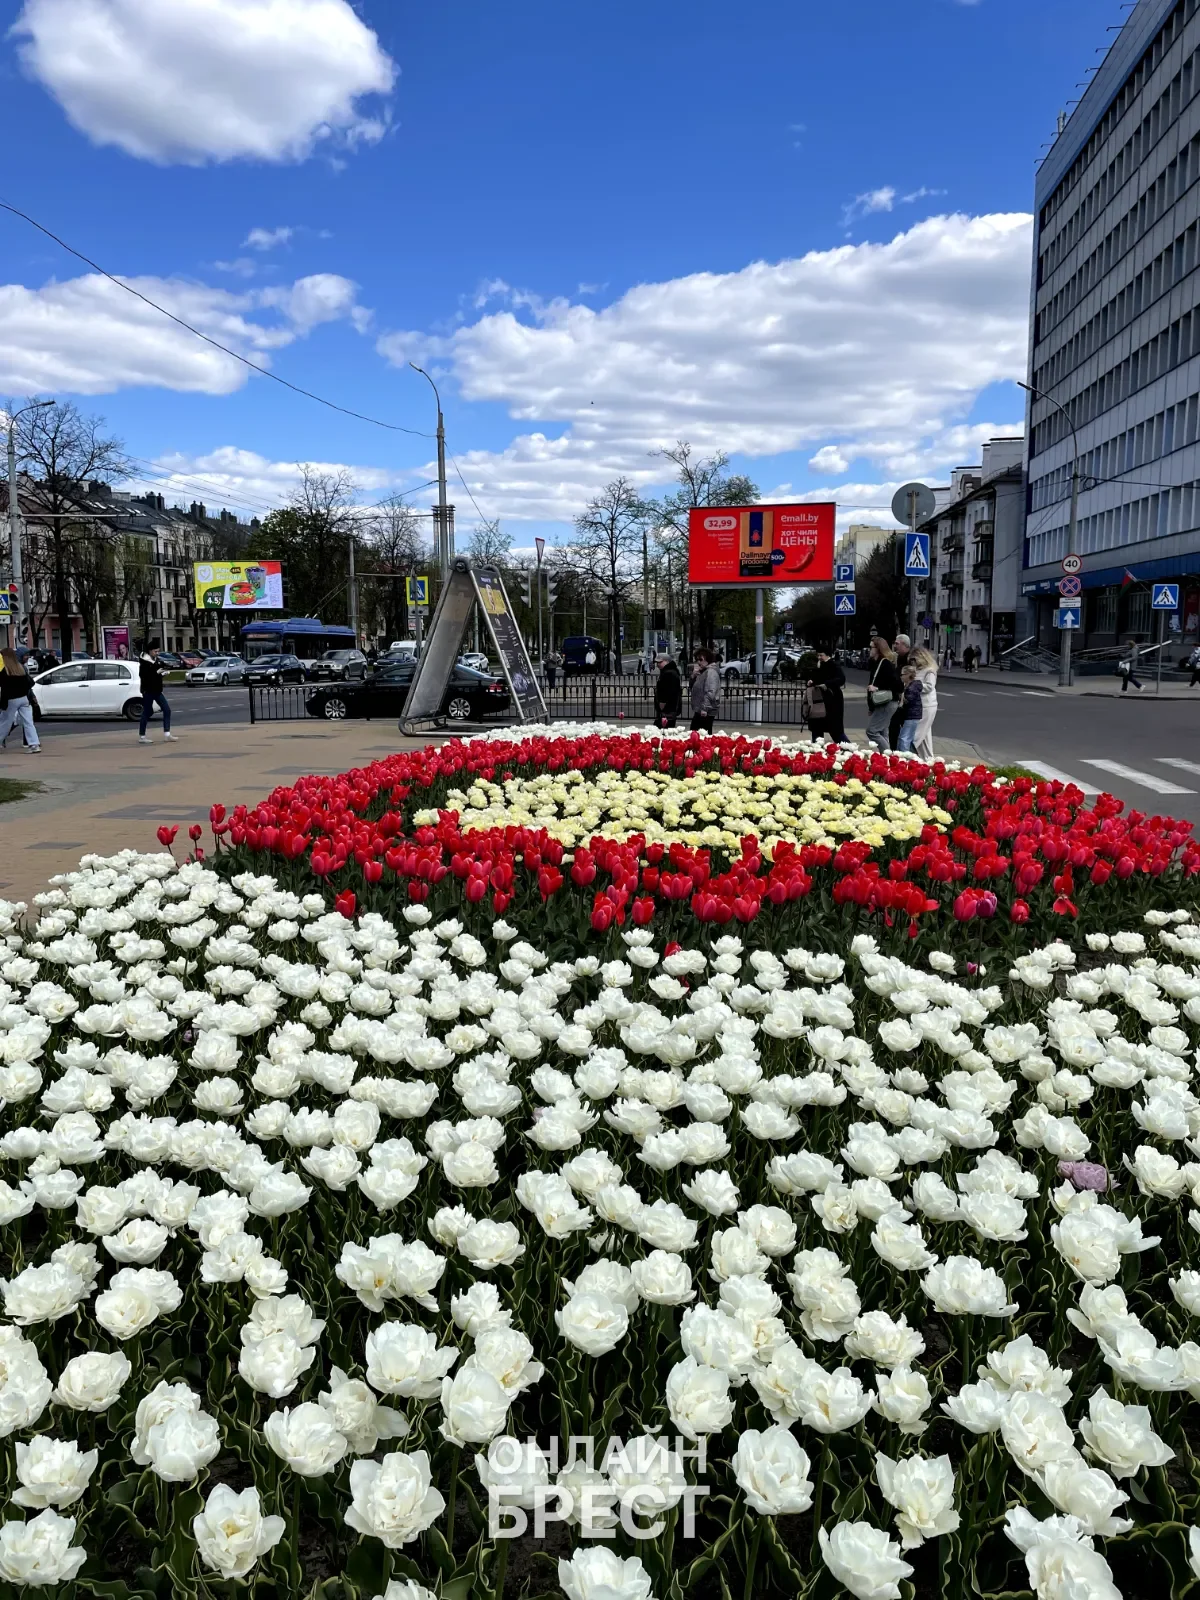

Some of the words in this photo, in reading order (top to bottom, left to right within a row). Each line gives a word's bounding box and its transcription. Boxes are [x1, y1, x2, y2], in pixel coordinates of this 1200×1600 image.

[708, 519, 732, 528] 32,99
[780, 536, 817, 547] ЦЕНЫ
[1065, 560, 1078, 568] 40
[840, 566, 850, 580] P
